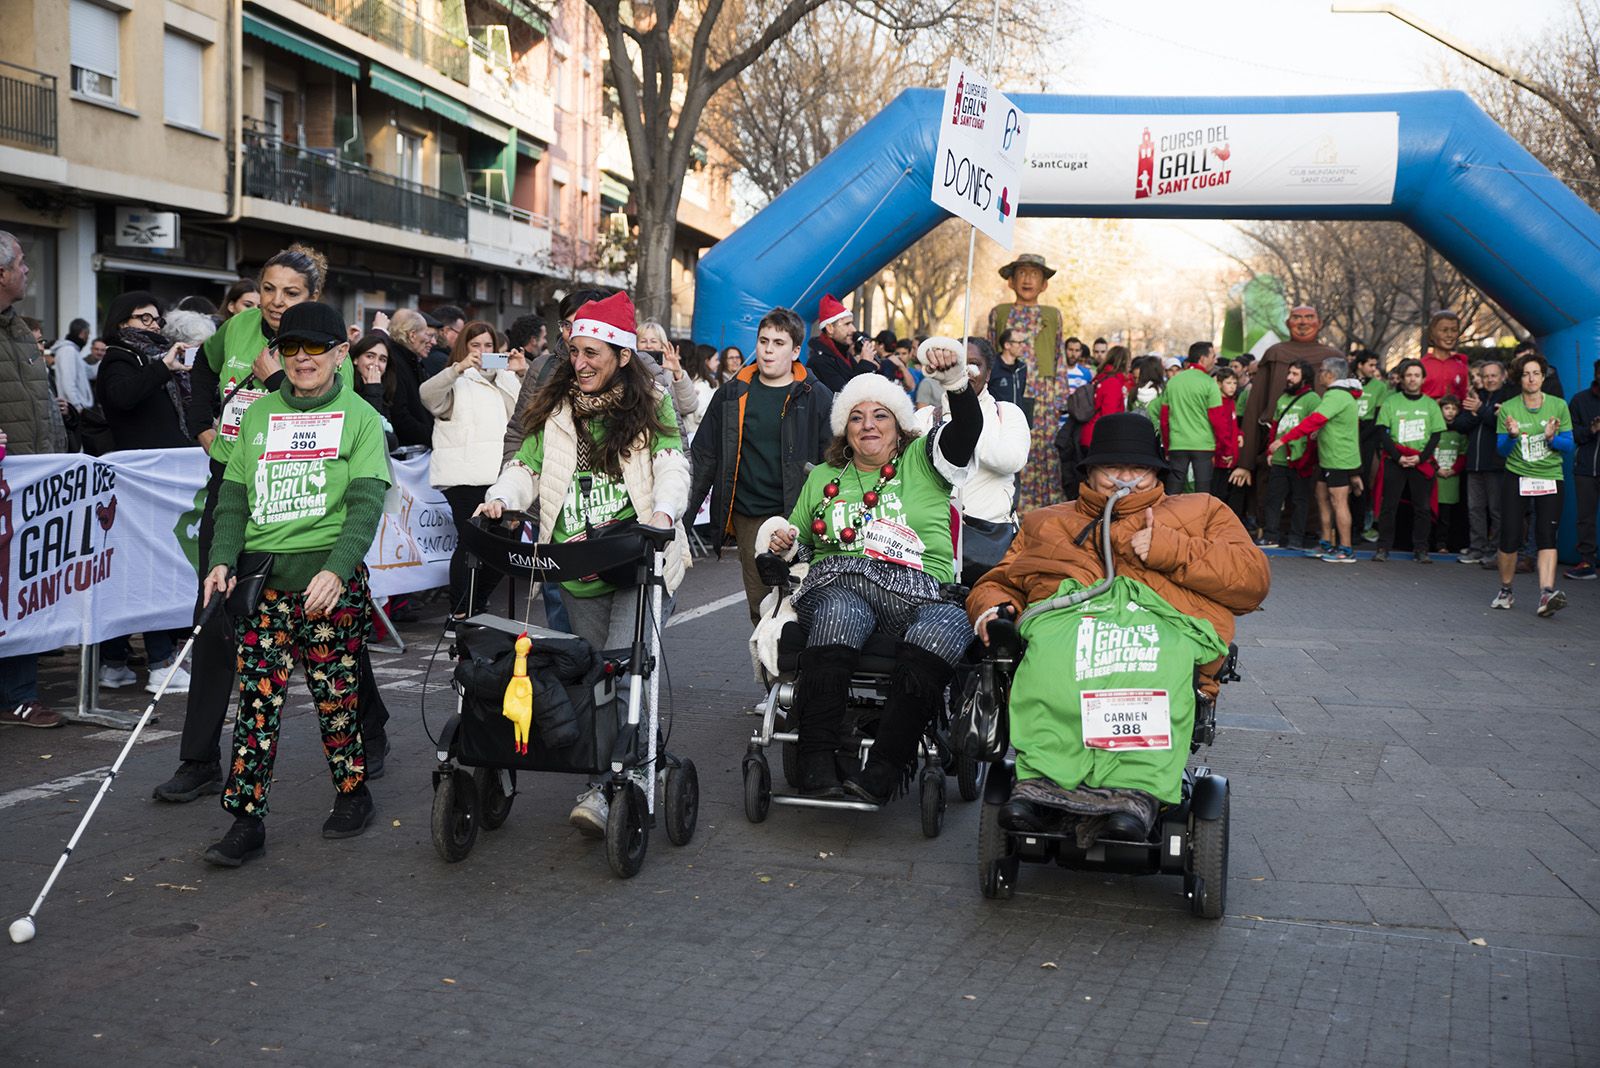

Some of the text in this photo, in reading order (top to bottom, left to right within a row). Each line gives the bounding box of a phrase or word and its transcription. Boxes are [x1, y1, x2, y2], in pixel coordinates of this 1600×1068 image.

[962, 97, 981, 117] GALL
[960, 115, 985, 130] SANT CUGAT
[1161, 125, 1229, 153] CURSA DEL
[1031, 160, 1088, 170] SantCugat
[1159, 149, 1211, 180] GALL
[944, 148, 994, 211] DONES
[1157, 170, 1231, 196] SANT CUGAT
[290, 440, 317, 450] 390
[293, 431, 317, 439] ANNA
[22, 465, 87, 522] CURSA
[270, 475, 311, 501] GALL
[881, 492, 898, 504] DEL
[266, 493, 328, 514] SANT CUGAT
[19, 504, 95, 581] GALL
[883, 546, 903, 559] 398
[508, 552, 560, 570] KMINA
[17, 567, 62, 620] SANT
[1095, 629, 1143, 653] GALL
[1094, 647, 1160, 667] SANT CUGAT
[1104, 711, 1148, 723] CARMEN
[1112, 723, 1141, 735] 388
